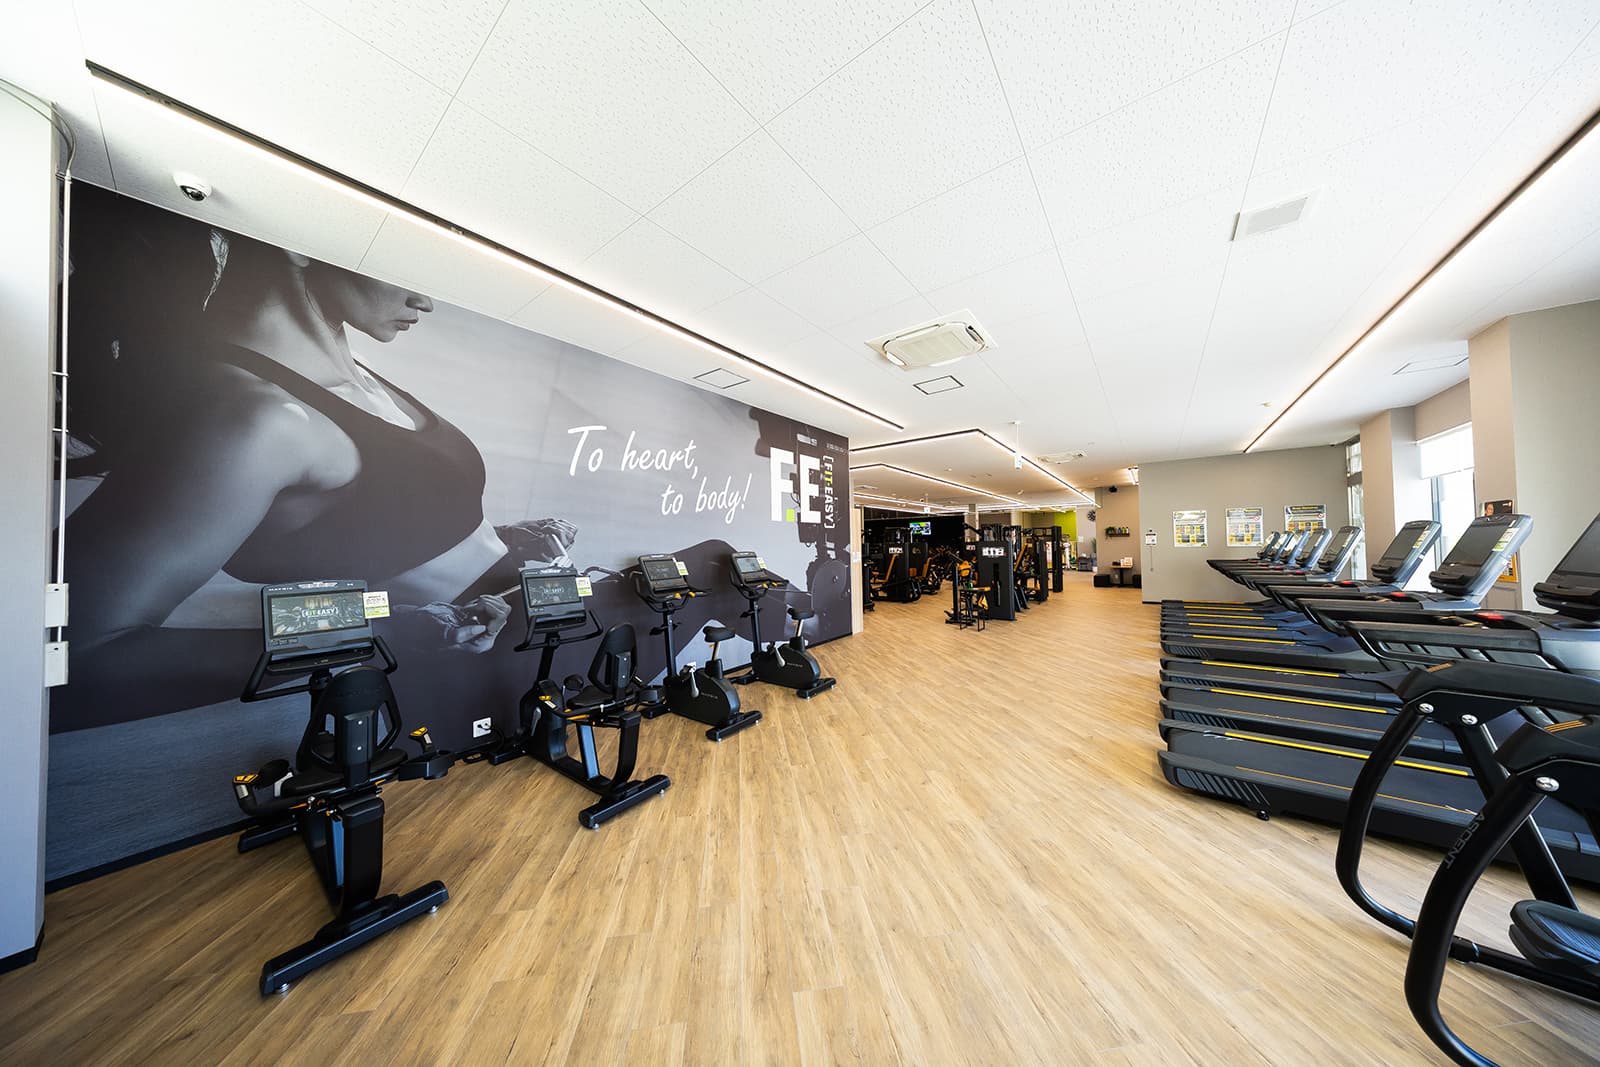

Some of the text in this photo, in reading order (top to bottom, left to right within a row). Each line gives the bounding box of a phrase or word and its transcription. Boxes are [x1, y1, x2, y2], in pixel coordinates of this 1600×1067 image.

[568, 425, 698, 479] To heart,
[660, 473, 752, 525] to body!
[1444, 812, 1485, 869] ASCENT
